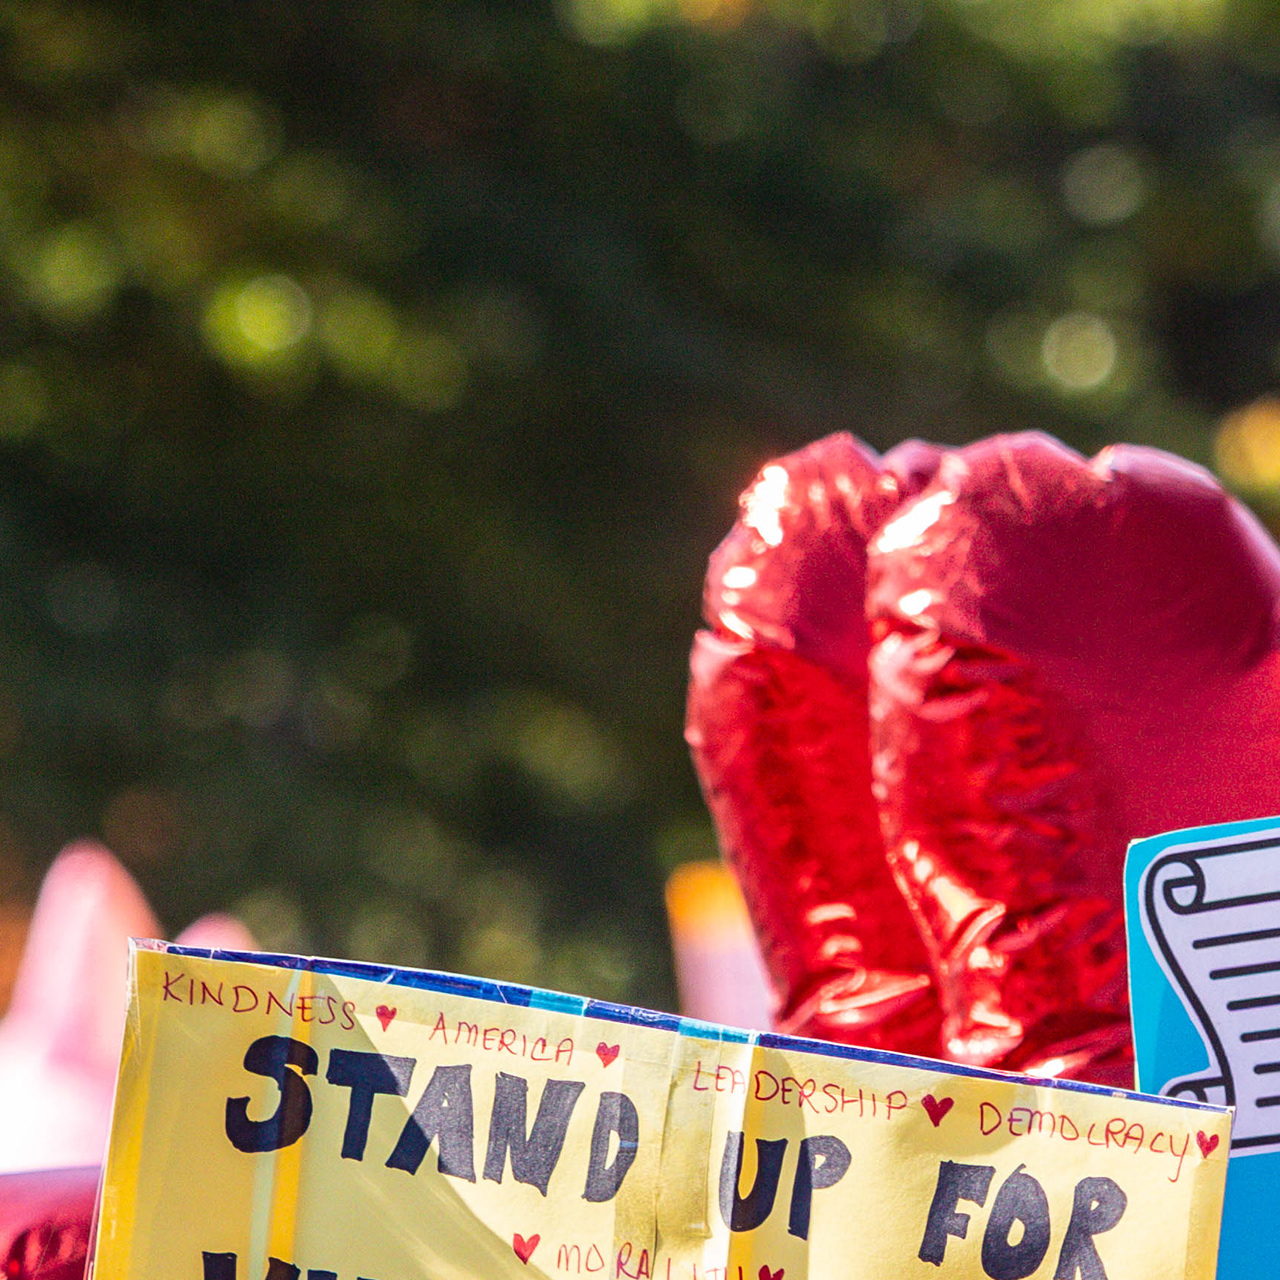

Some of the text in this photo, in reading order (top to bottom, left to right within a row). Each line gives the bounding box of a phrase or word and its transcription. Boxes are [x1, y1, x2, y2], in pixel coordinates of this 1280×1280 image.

[162, 971, 1191, 1183] KINDNESS AMERICA LEADERSHIP DEMOCRACY
[225, 1034, 640, 1203] STAND
[719, 1129, 853, 1241] UP
